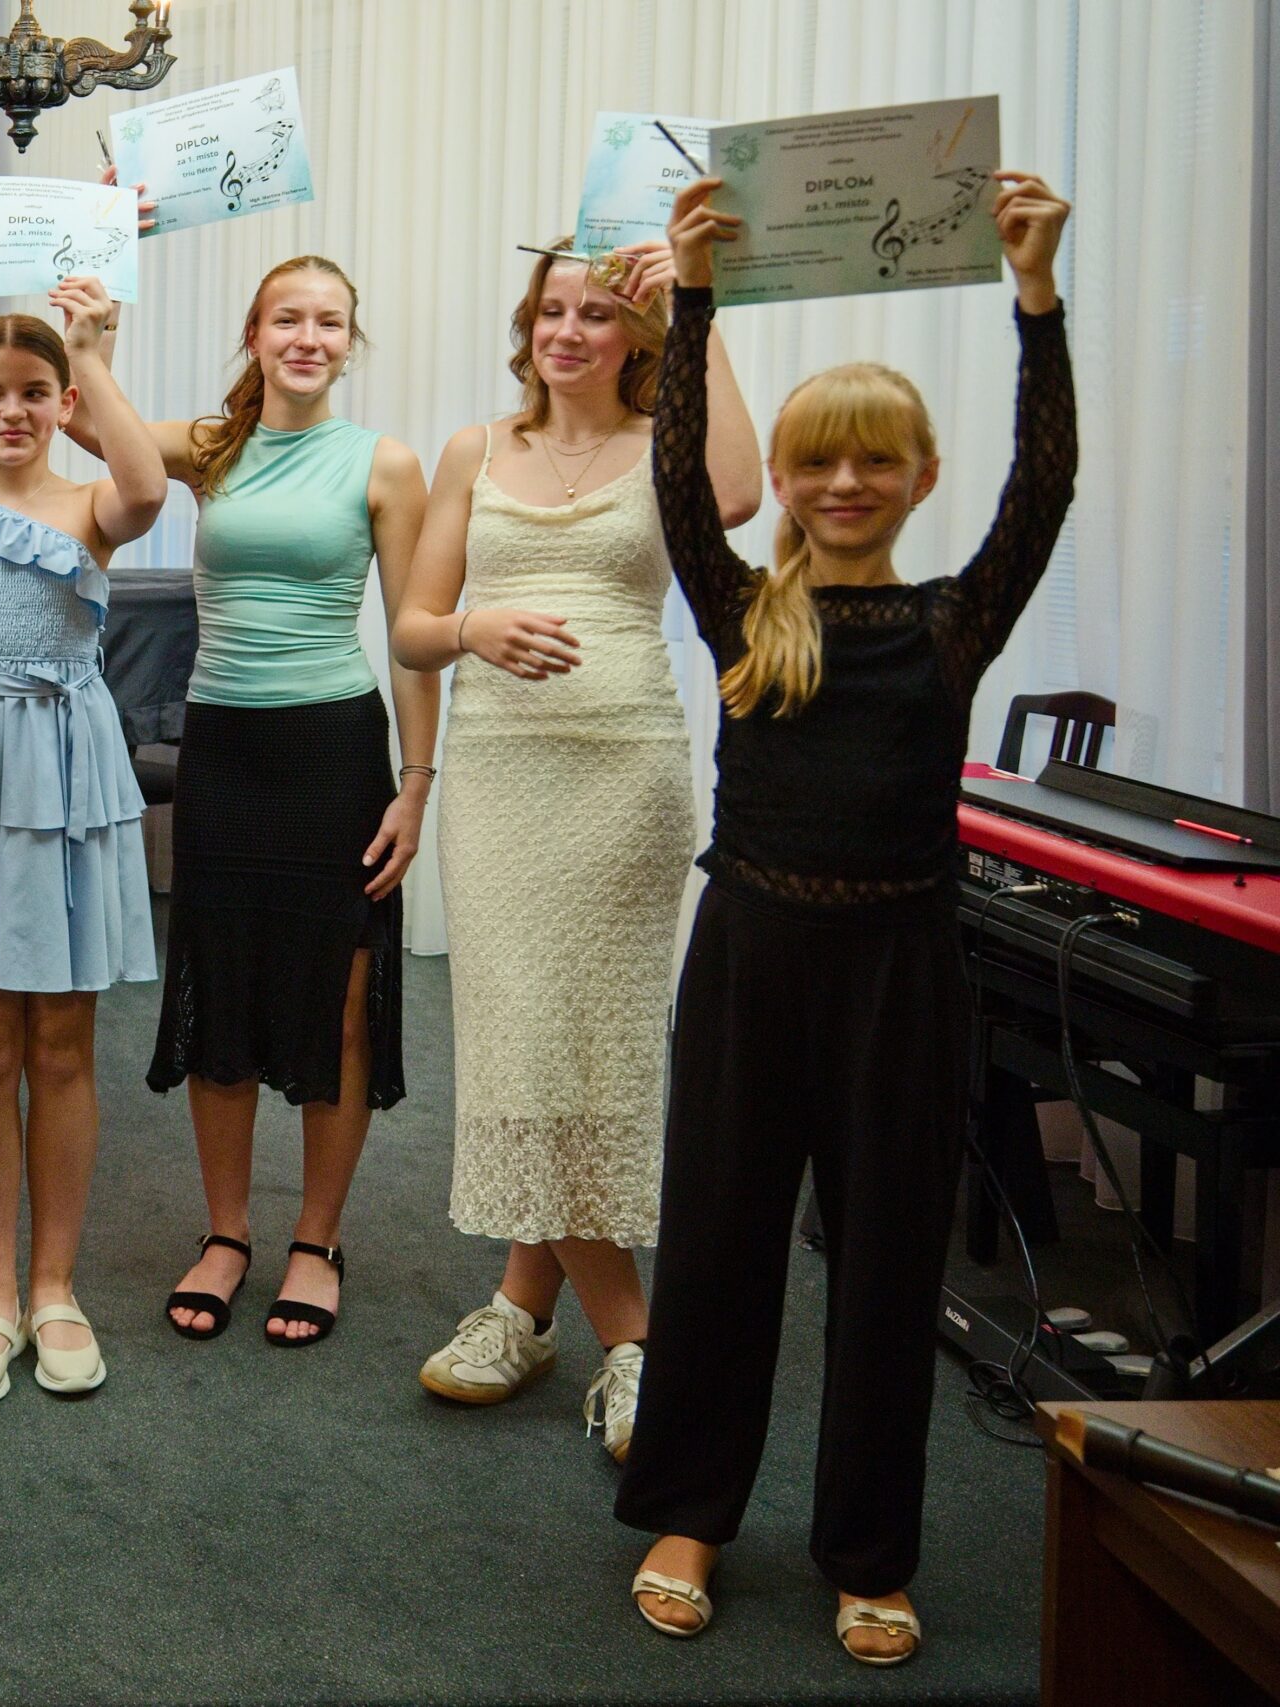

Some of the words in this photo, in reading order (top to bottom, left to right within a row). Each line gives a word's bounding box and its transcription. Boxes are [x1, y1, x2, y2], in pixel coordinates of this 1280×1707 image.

[175, 134, 220, 152] DIPLOM
[177, 158, 186, 166] za
[196, 149, 219, 161] místo
[182, 170, 195, 178] triu
[806, 174, 874, 193] DIPLOM
[9, 215, 55, 226] DIPLOM
